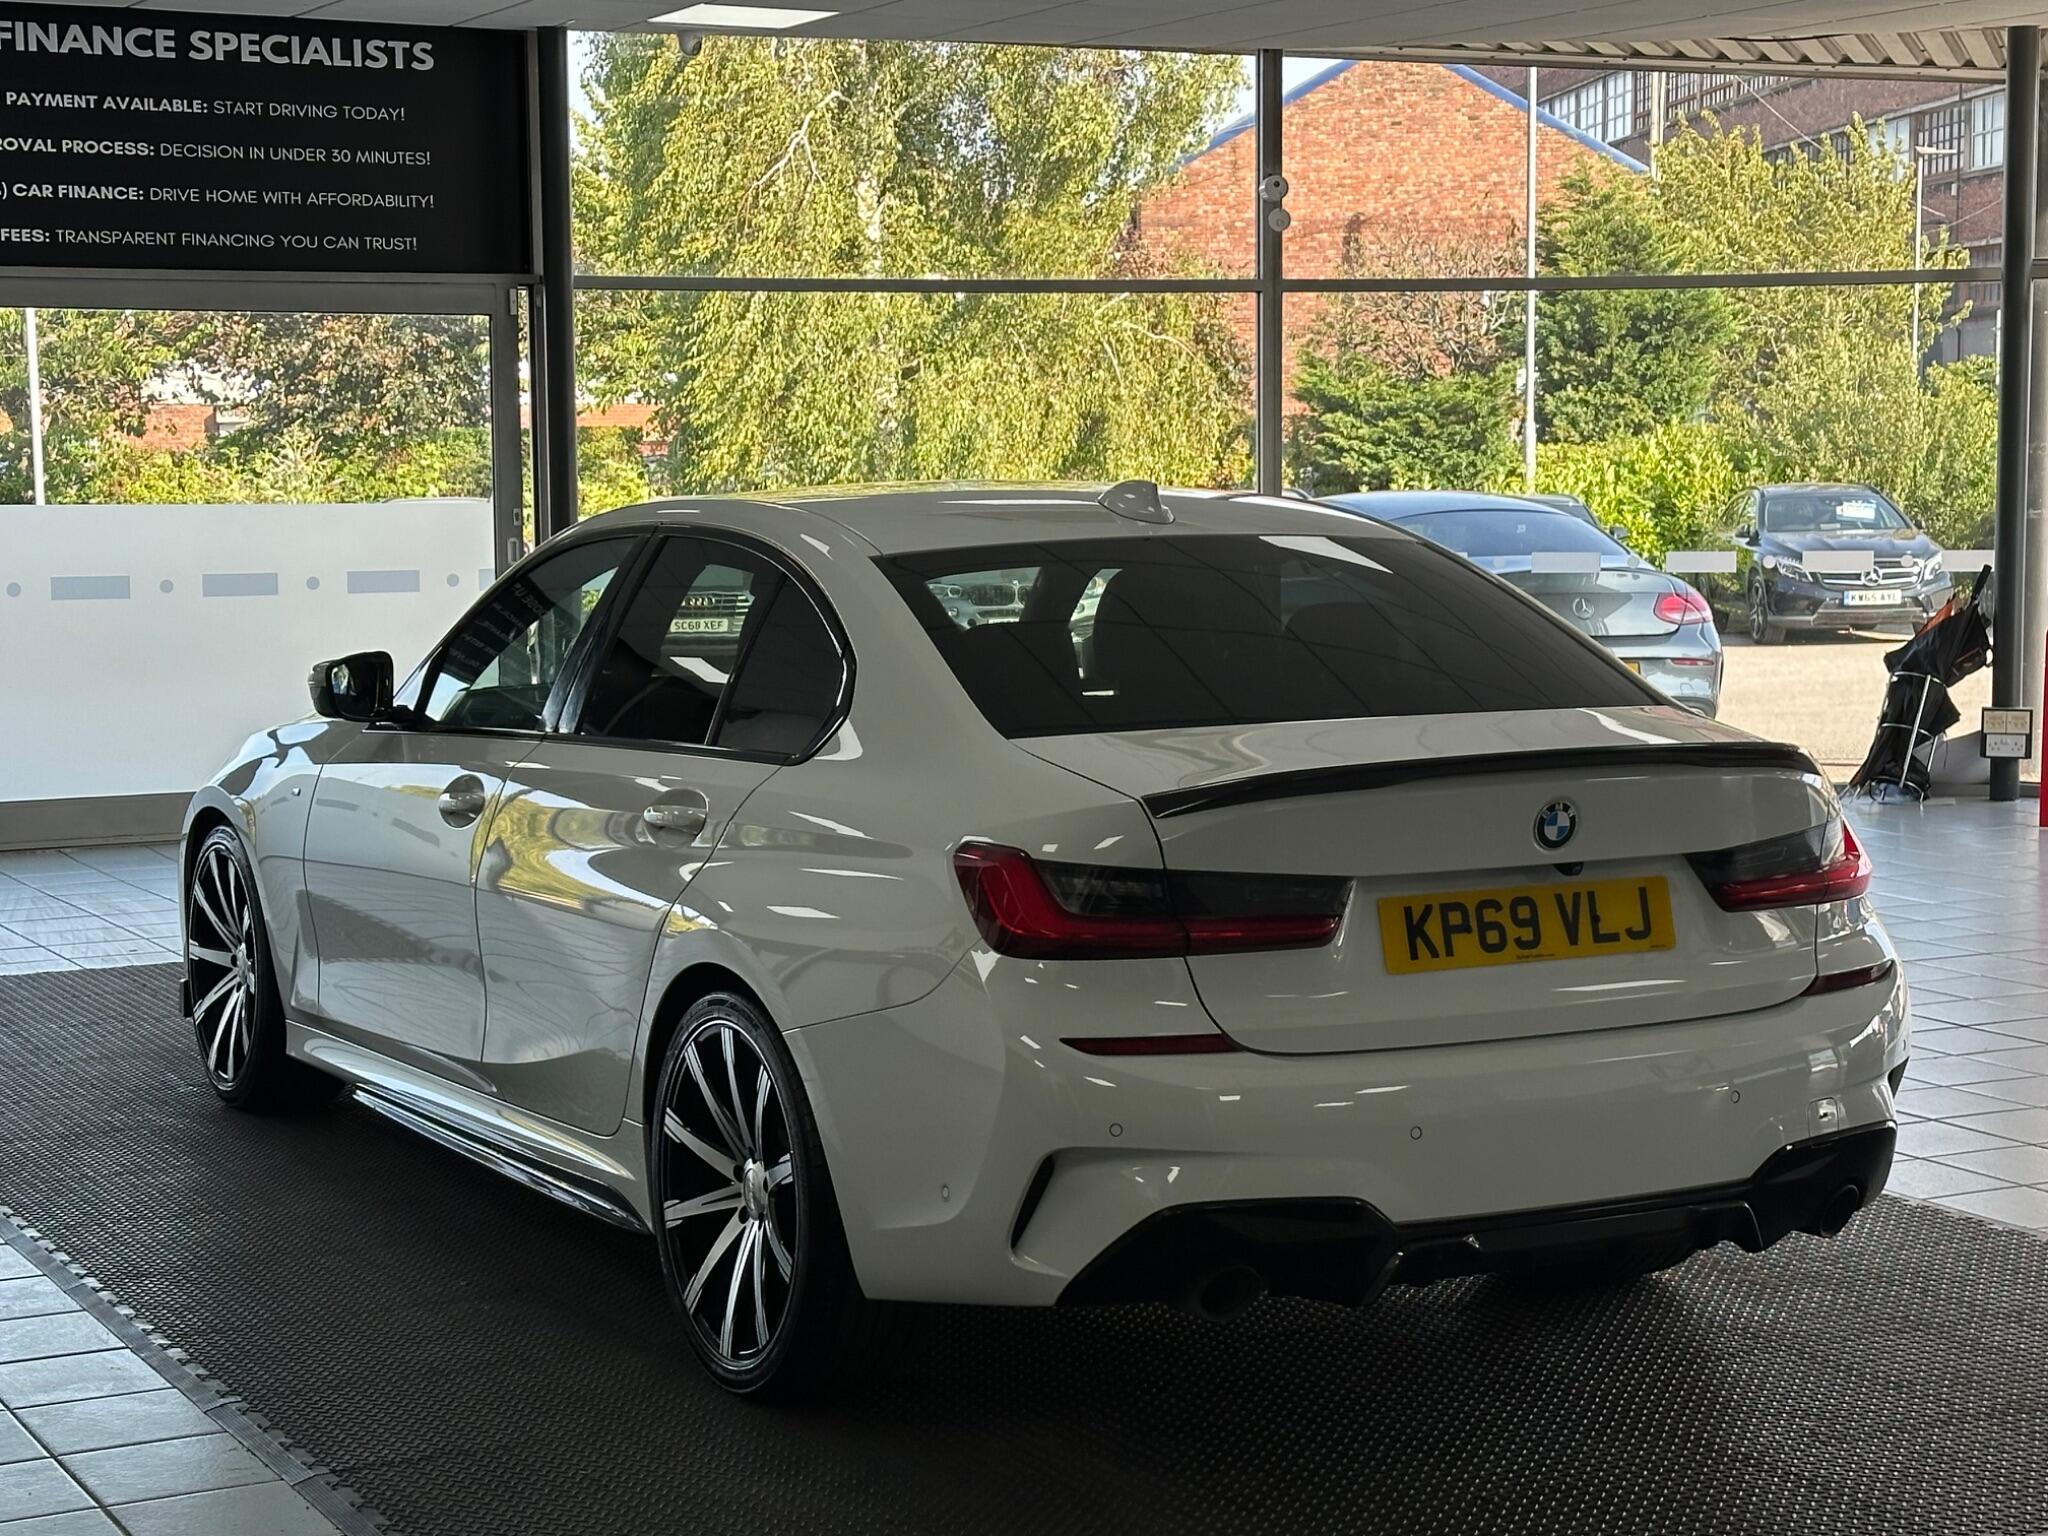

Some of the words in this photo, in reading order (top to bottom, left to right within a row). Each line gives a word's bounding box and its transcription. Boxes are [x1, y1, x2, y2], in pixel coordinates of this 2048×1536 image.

[0, 21, 175, 58] FINANCE
[189, 31, 434, 70] SPECIALISTS
[6, 92, 98, 108] PAYMENT
[103, 96, 207, 113] AVAILABLE:
[214, 101, 263, 115] START
[270, 103, 337, 118] DRIVING
[343, 106, 404, 120] TODAY!
[0, 138, 56, 152] OVAL
[62, 140, 154, 155] PROCESS:
[161, 143, 243, 158] DECISION
[250, 147, 264, 159] IN
[270, 148, 326, 161] UNDER
[332, 149, 351, 162] 30
[356, 151, 430, 165] MINUTES!
[13, 184, 53, 197] CAR
[58, 185, 143, 200] FINANCE:
[150, 188, 200, 201] DRIVE
[206, 190, 257, 203] HOME
[263, 192, 301, 204] WITH
[307, 193, 433, 208] AFFORDABILITY!
[1, 229, 50, 242] FEES:
[56, 230, 175, 245] TRANSPARENT
[182, 233, 274, 247] FINANCING
[280, 235, 317, 248] YOU
[324, 236, 358, 249] CAN
[364, 237, 416, 250] TRUST!
[1403, 895, 1541, 961] KP69
[1554, 886, 1652, 946] VLJ
